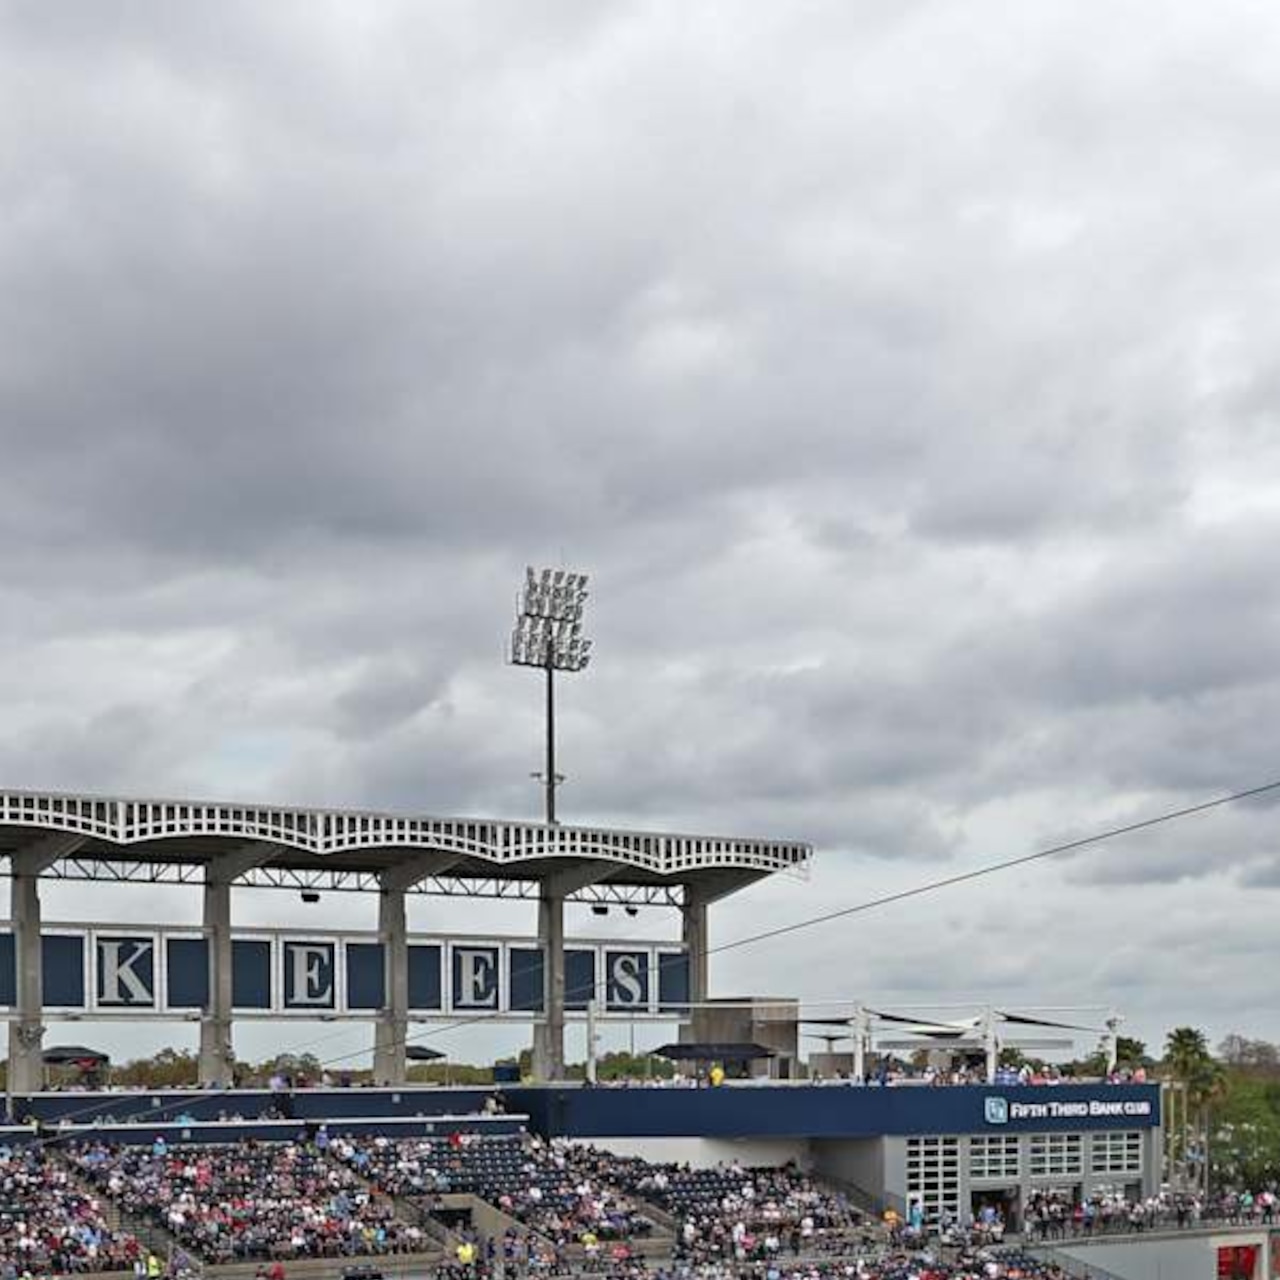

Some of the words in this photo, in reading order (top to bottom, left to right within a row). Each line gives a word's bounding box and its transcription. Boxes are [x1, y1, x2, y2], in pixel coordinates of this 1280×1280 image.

[1010, 1103, 1047, 1118] FIFTH
[1048, 1102, 1089, 1117] THIRD
[1090, 1101, 1123, 1116] BANK
